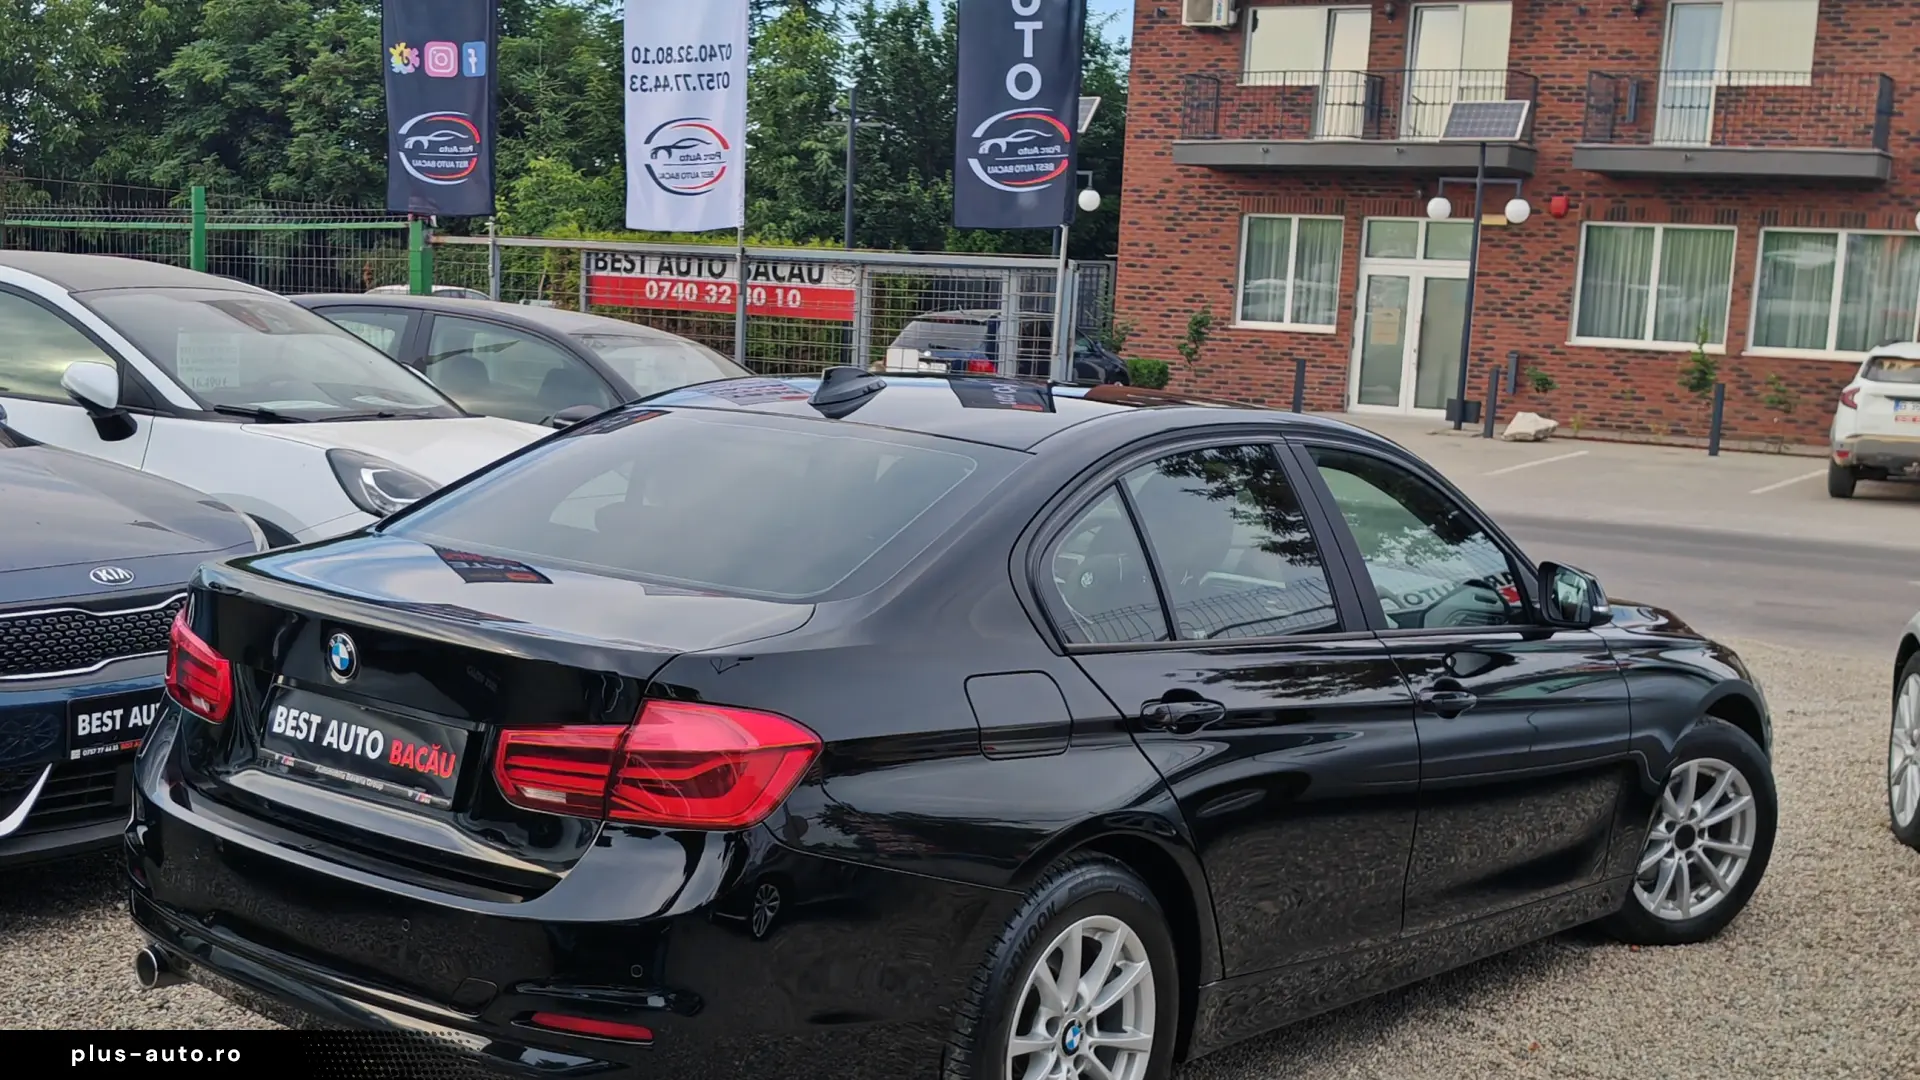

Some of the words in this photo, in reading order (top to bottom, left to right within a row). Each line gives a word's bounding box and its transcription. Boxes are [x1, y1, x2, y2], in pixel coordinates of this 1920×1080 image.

[595, 252, 645, 274] BEST
[657, 255, 727, 279] AUTO
[748, 261, 824, 284] ACAU
[645, 280, 698, 301] 0740
[704, 284, 732, 304] 32
[775, 288, 801, 308] 10
[96, 568, 131, 581] KIA
[77, 708, 124, 736] BEST
[272, 705, 322, 743] BEST
[322, 720, 384, 760] AUTO
[389, 738, 456, 779] BACĂU
